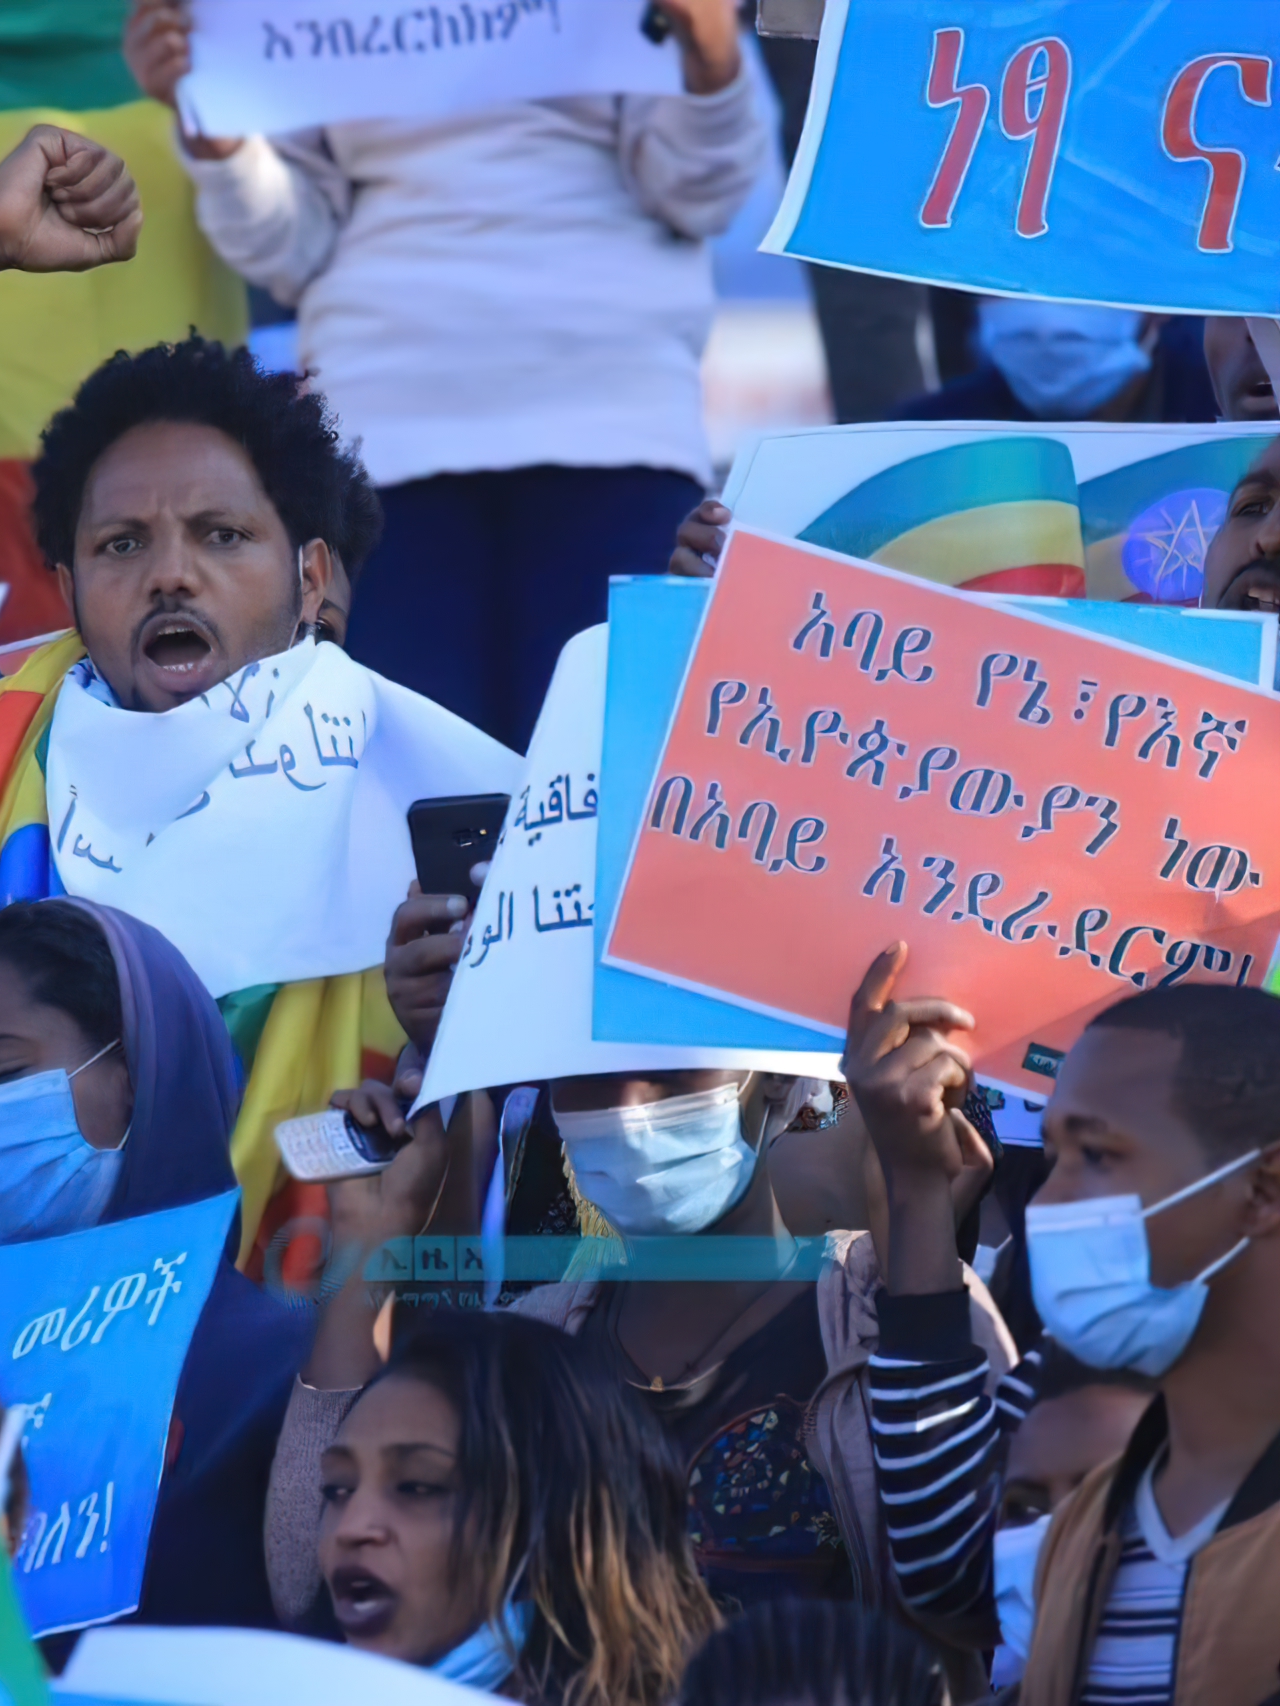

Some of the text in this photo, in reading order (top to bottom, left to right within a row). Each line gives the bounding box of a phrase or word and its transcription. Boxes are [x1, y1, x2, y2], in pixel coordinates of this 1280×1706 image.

[1161, 52, 1280, 254] ና
[792, 592, 934, 683] አባይ
[651, 775, 827, 874] በአባይ
[1160, 817, 1262, 893] ነው
[12, 1251, 188, 1360] መሪዎች
